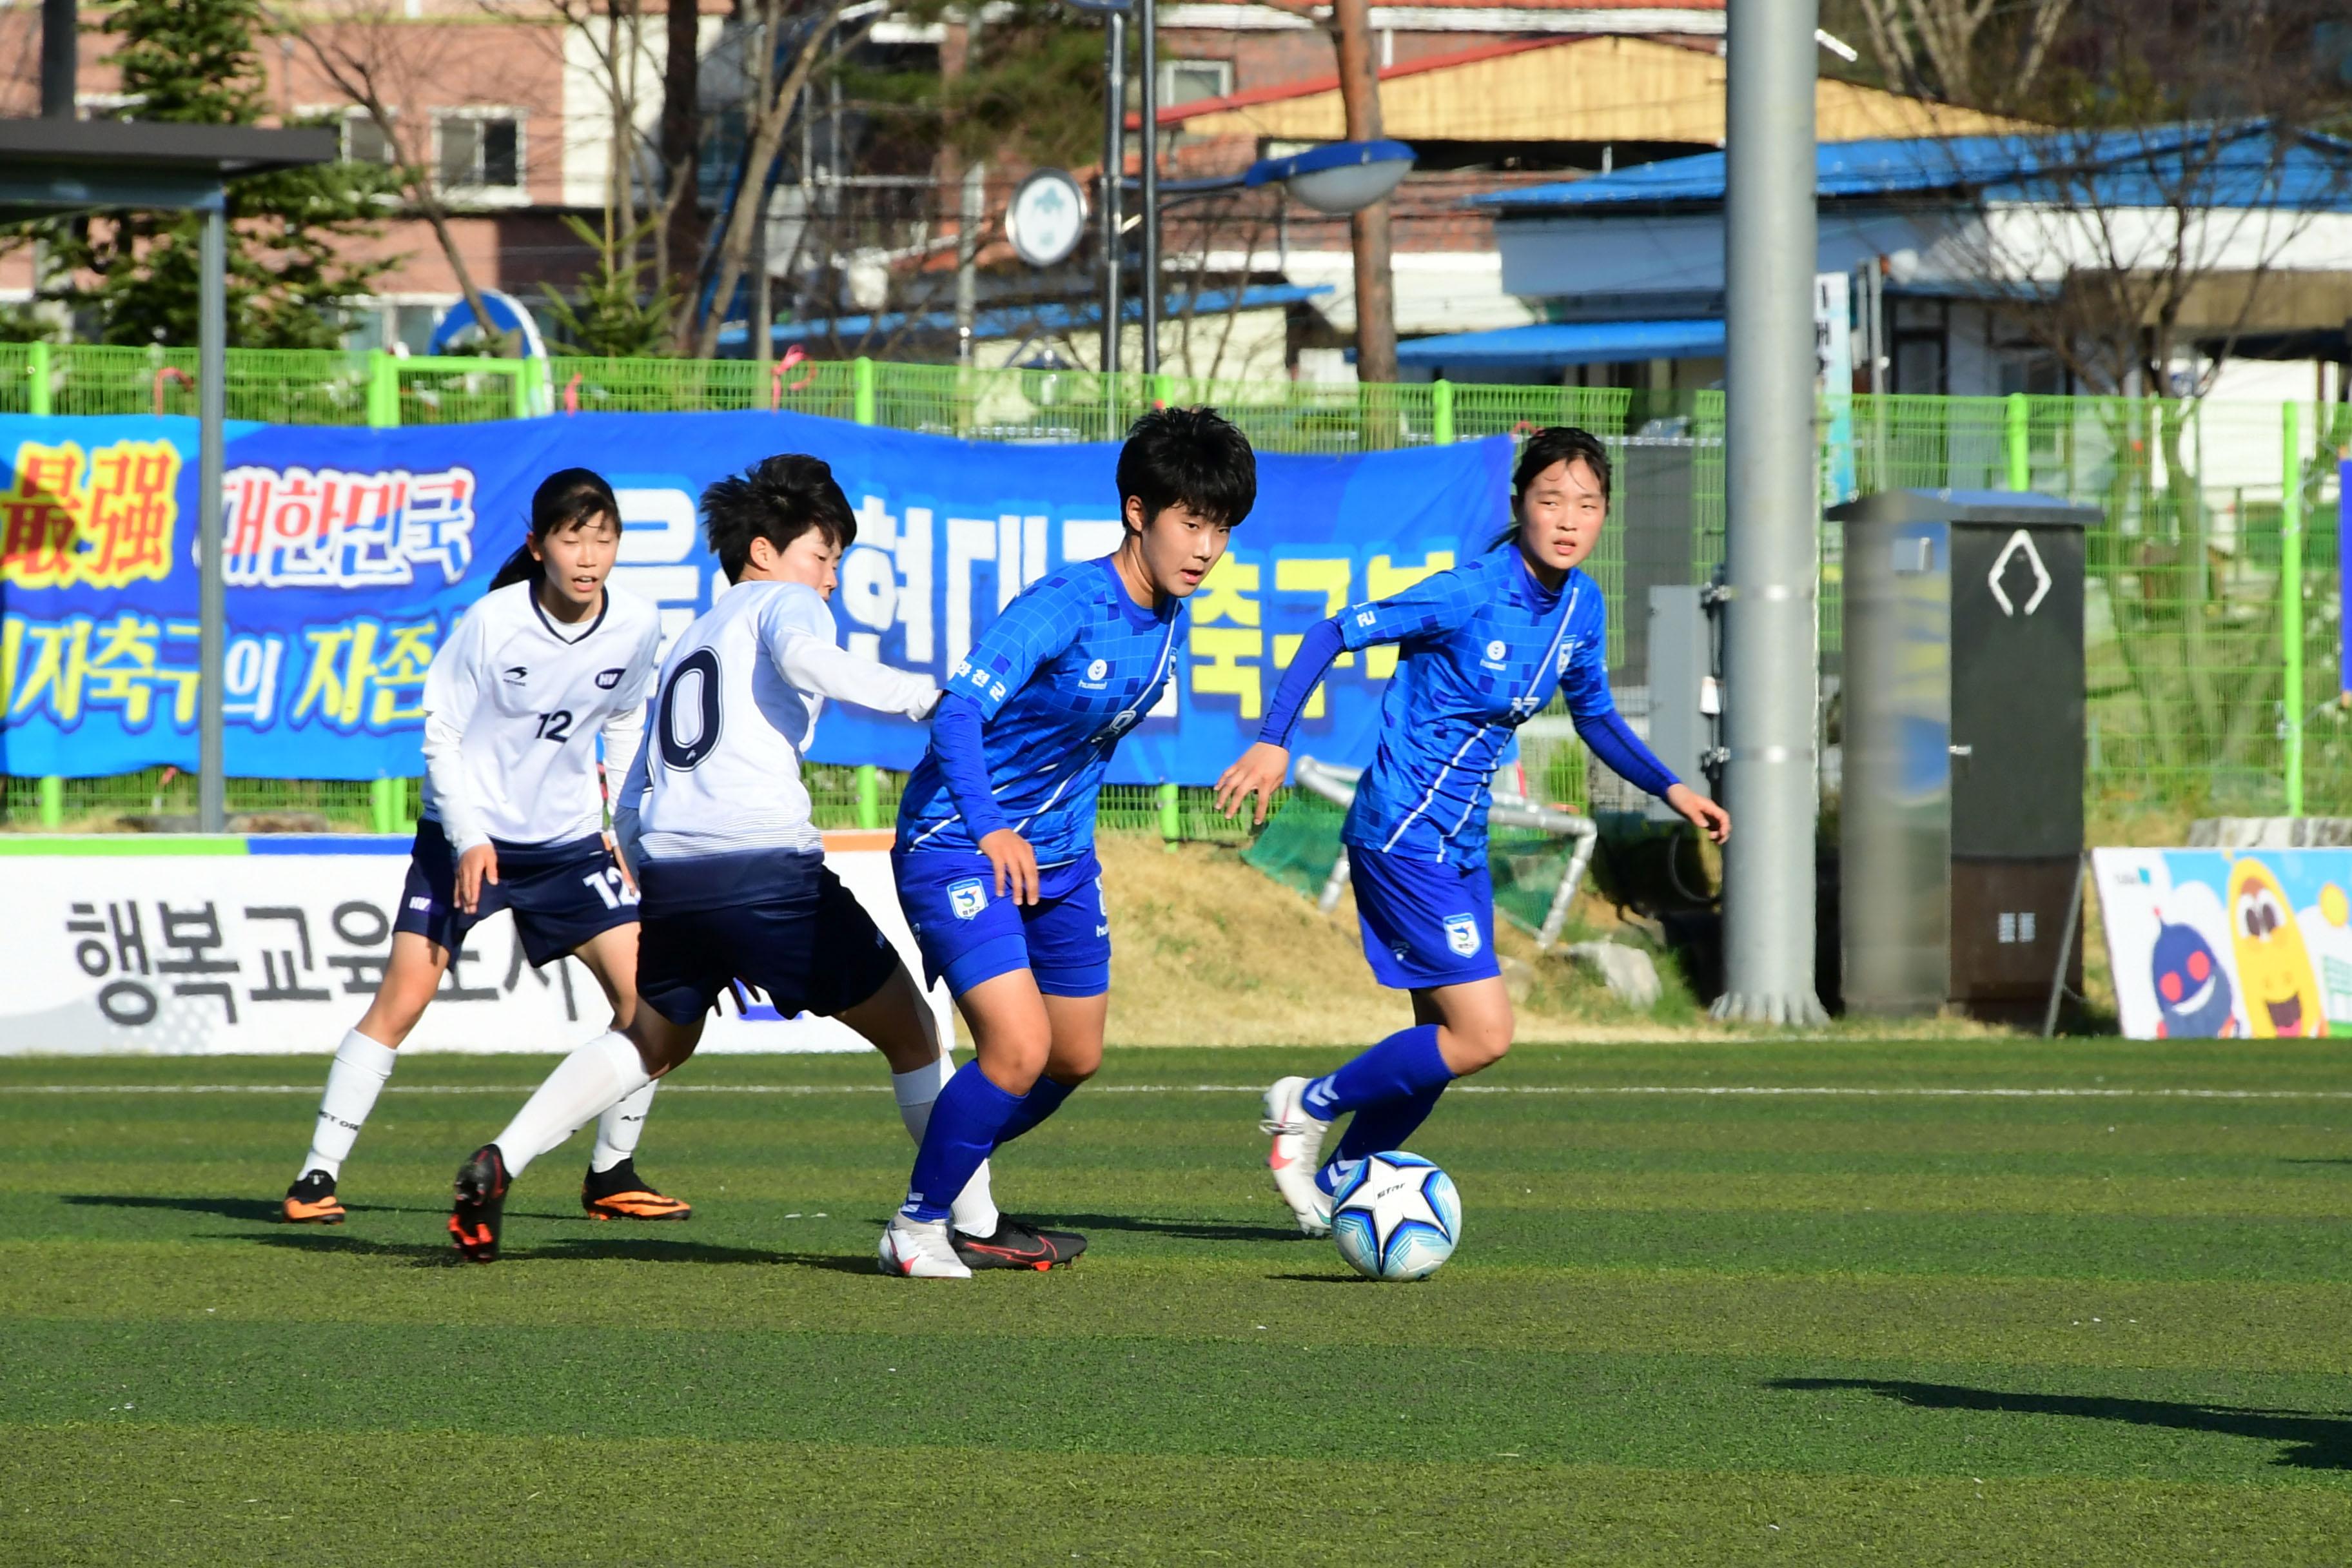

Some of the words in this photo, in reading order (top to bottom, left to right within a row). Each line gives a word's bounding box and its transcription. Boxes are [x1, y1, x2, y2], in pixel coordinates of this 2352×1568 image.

[193, 466, 474, 587] 대한민국
[0, 617, 282, 723] 자축구의
[293, 617, 464, 723] 자존
[535, 709, 573, 744] 12
[582, 866, 642, 910] 12
